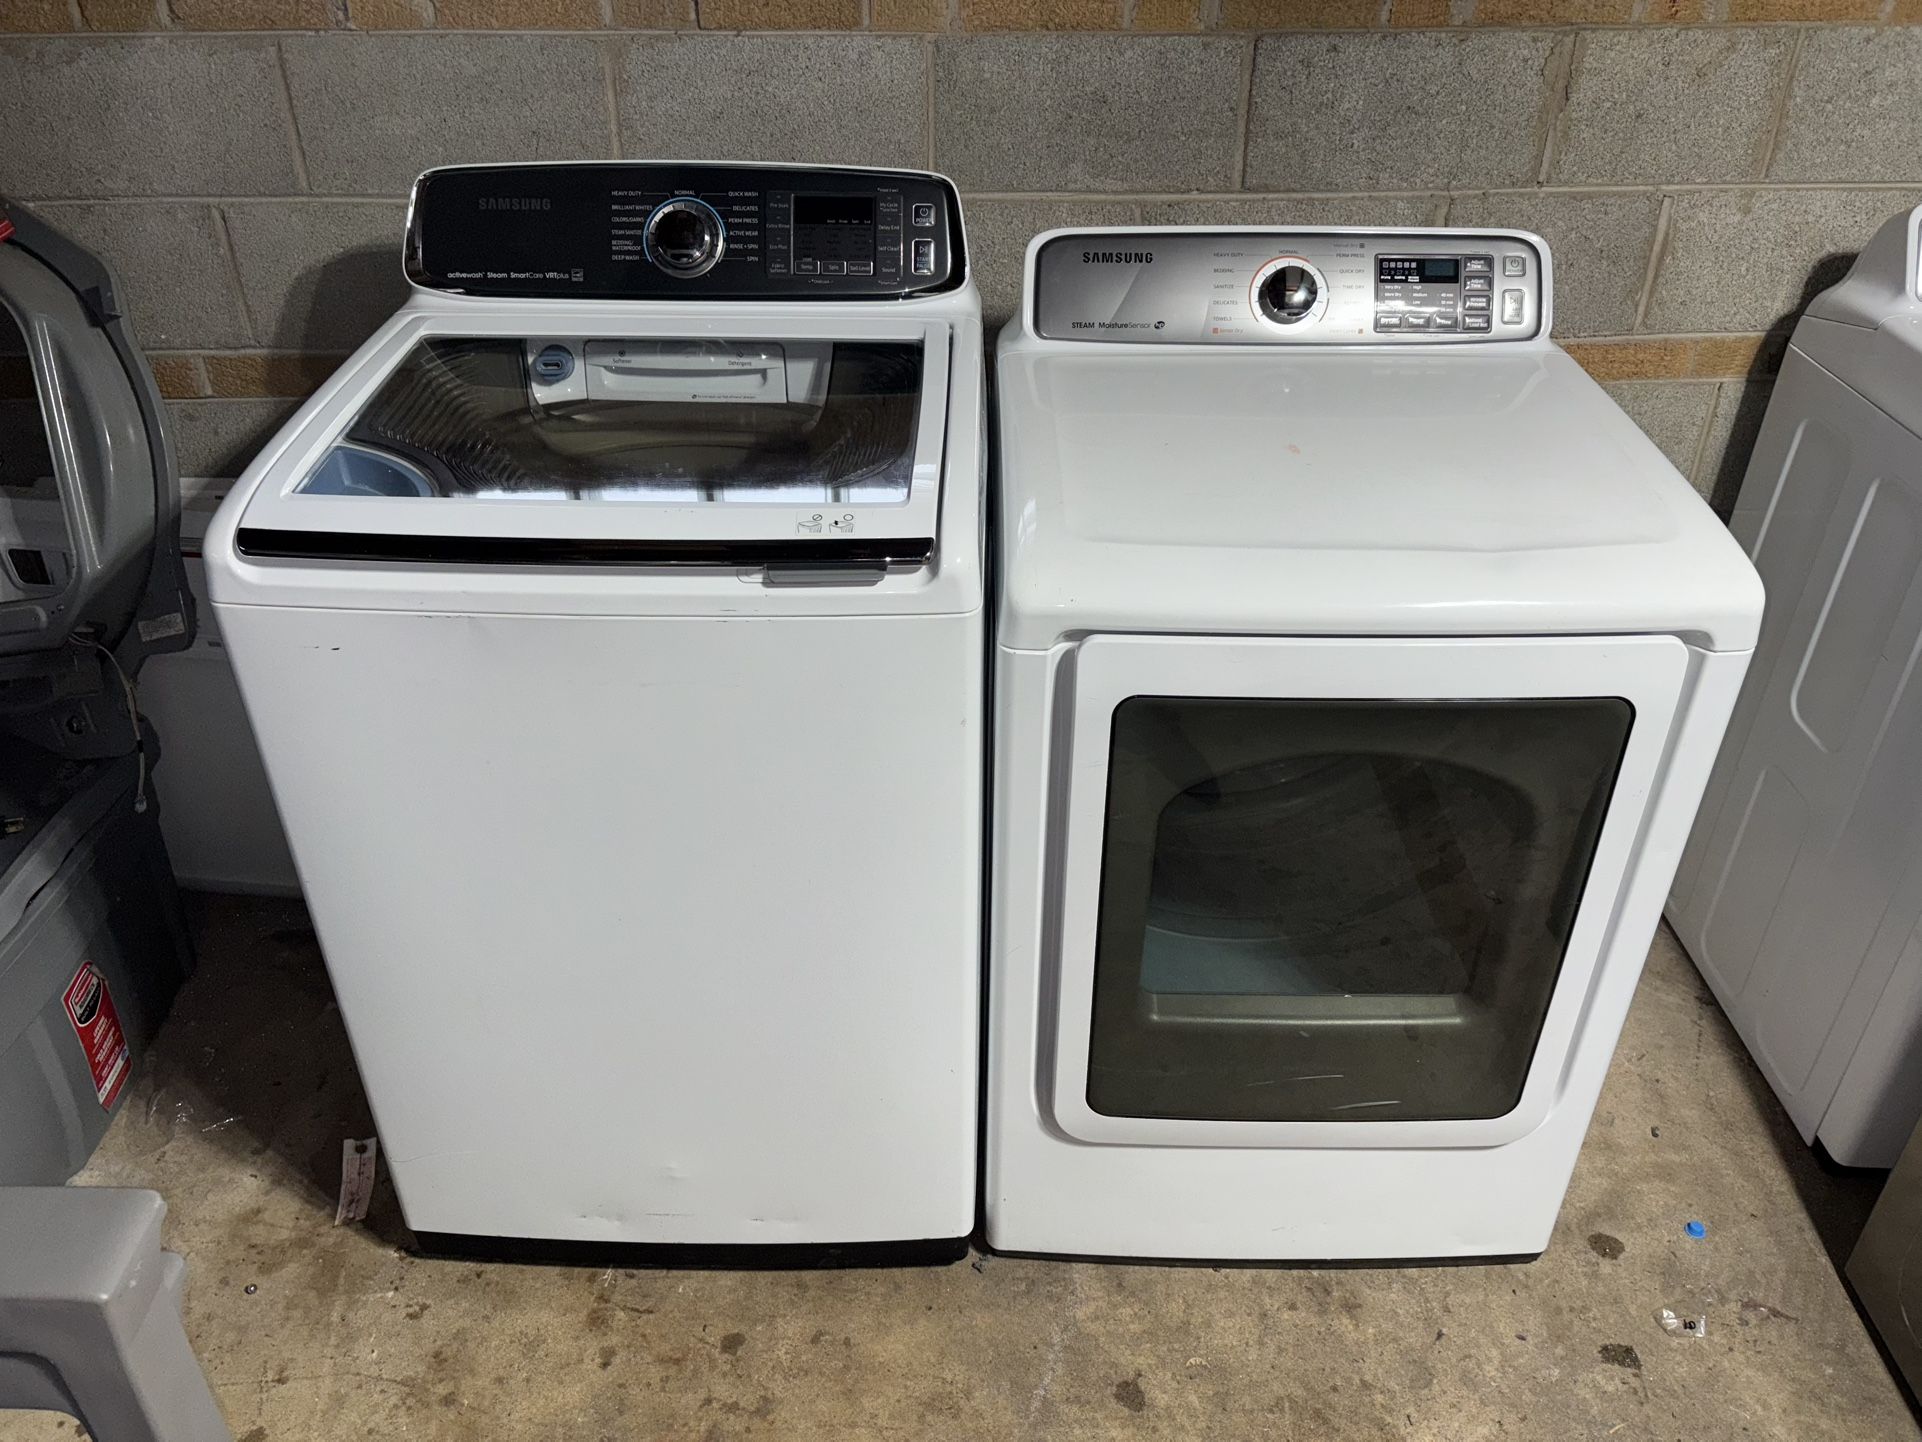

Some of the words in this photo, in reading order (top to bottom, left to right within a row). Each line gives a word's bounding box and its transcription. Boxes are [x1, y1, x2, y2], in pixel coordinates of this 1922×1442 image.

[478, 198, 552, 210] SAMSUNG
[1082, 252, 1153, 264] SAMSUNG
[487, 271, 508, 279] Steam
[510, 271, 544, 279] SmartCare
[545, 271, 570, 280] VRTplus
[1072, 321, 1095, 329] STEAM
[1098, 321, 1151, 329] MoistureSensor
